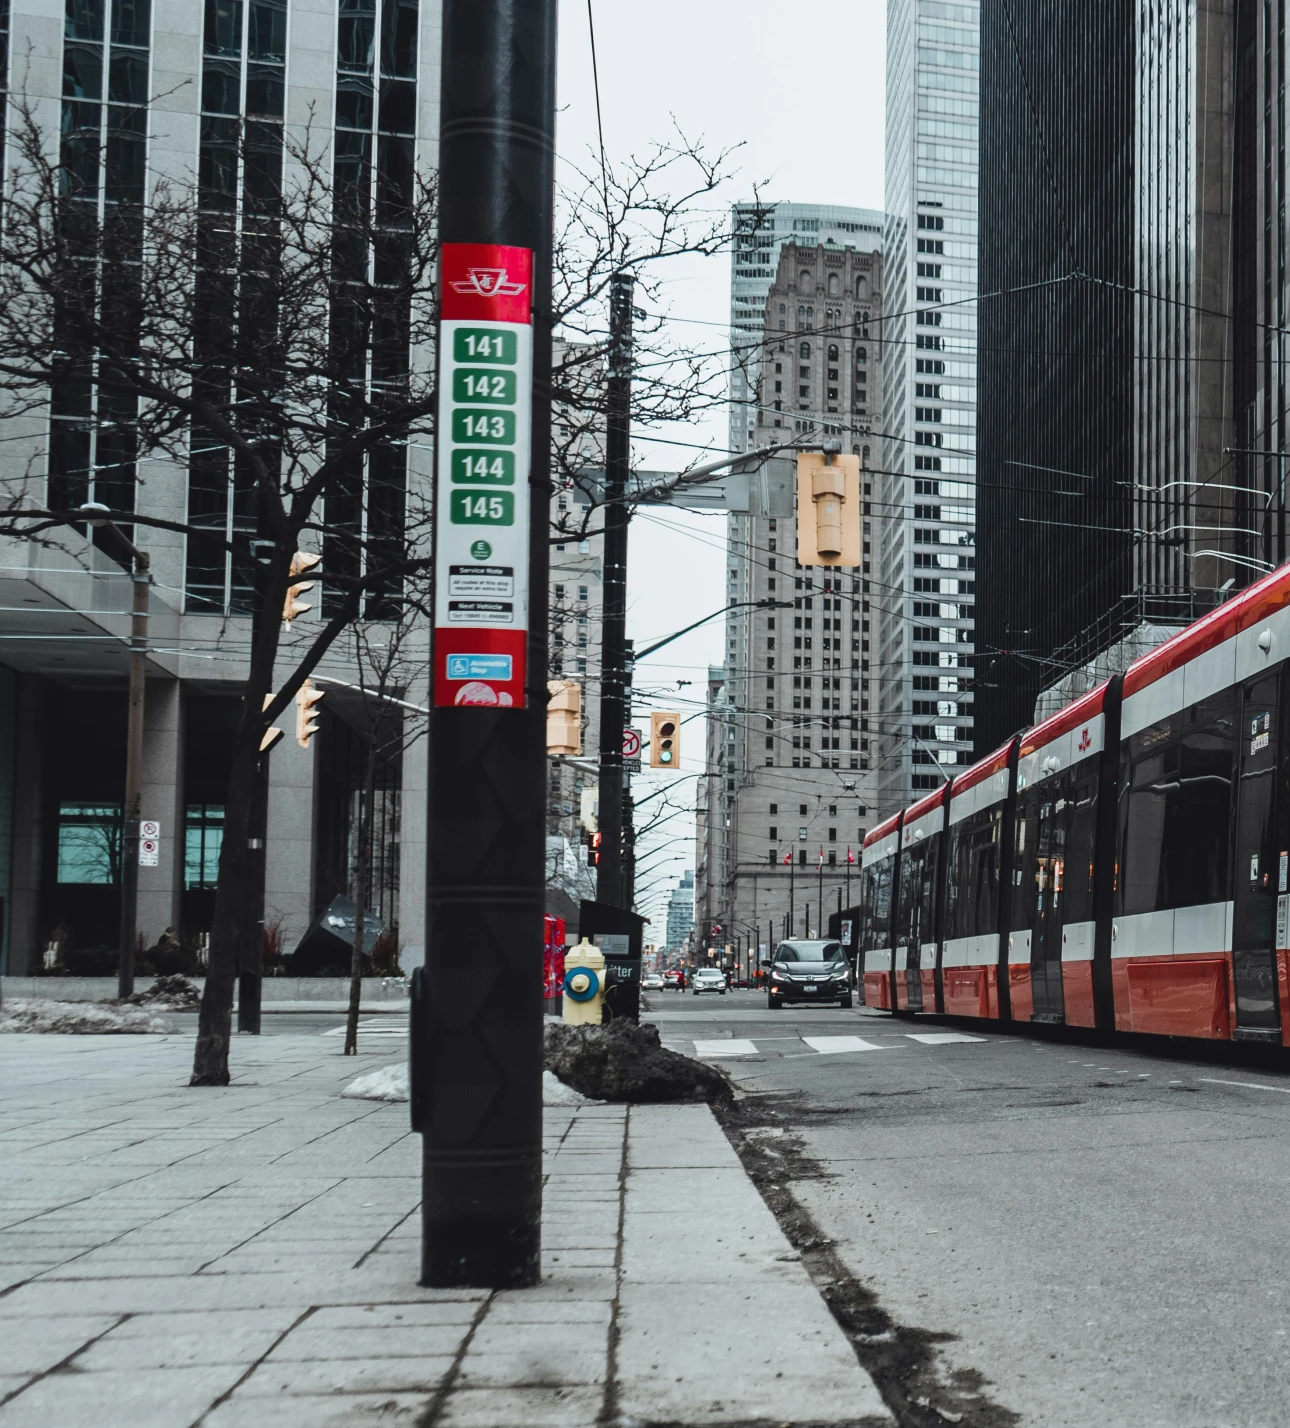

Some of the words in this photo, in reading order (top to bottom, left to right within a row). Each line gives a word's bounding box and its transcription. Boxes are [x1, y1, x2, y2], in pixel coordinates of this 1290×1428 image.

[463, 334, 503, 358] 141
[462, 374, 506, 398] 142
[461, 415, 505, 438] 143
[460, 455, 505, 479] 144
[460, 496, 504, 519] 145
[604, 964, 633, 978] ter
